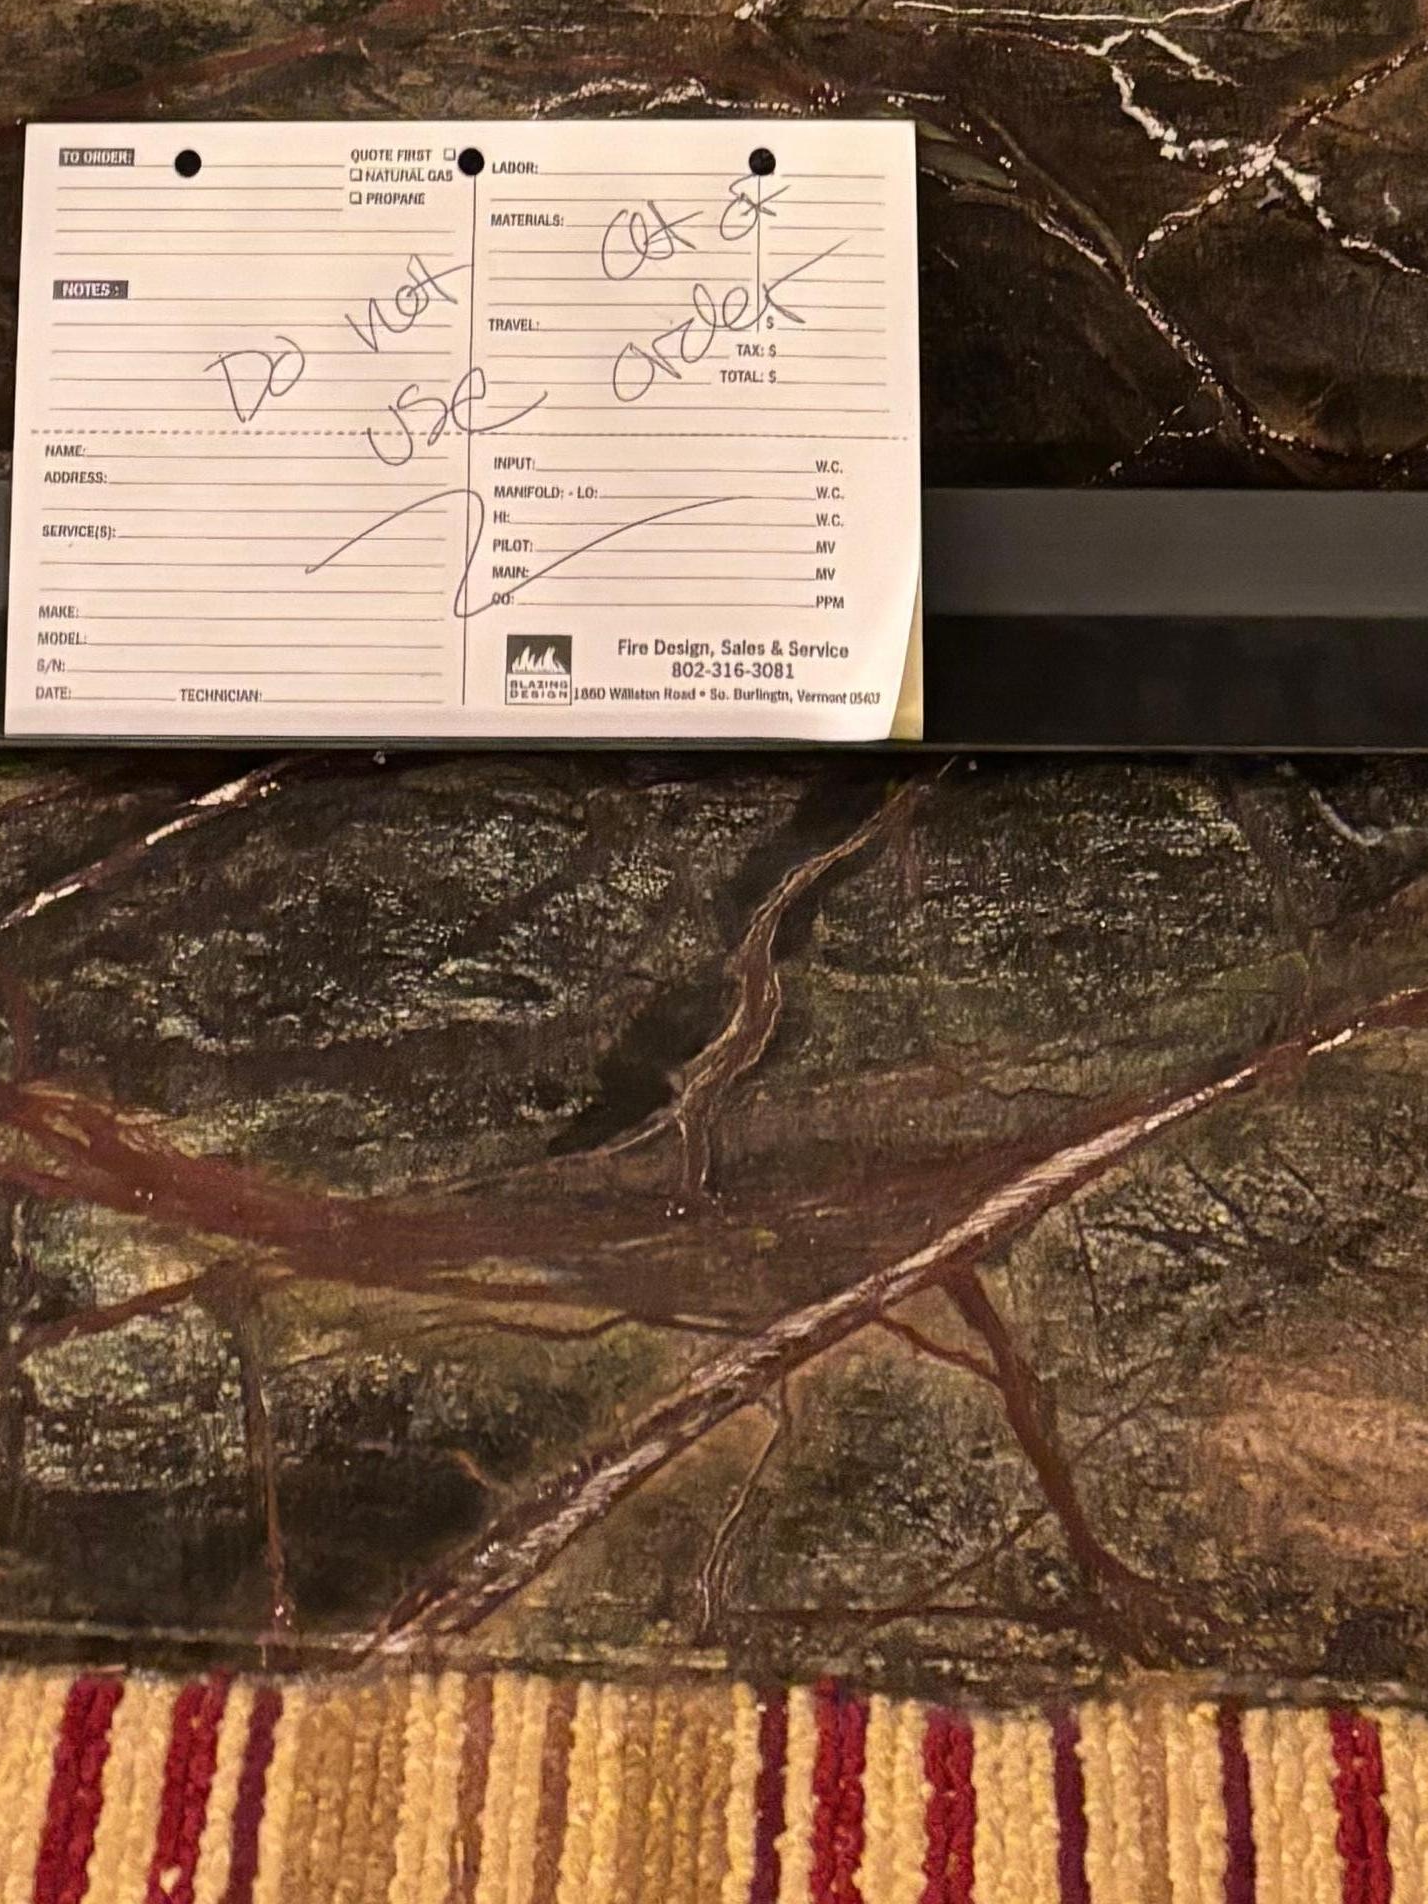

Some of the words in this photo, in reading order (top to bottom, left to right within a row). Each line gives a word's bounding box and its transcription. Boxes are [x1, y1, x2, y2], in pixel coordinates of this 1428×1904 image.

[63, 150, 80, 164] TO
[83, 150, 134, 164] ORDER:
[350, 149, 393, 163] QUOTE
[397, 149, 432, 162] FIRST
[365, 169, 424, 182] NATURAL
[428, 170, 453, 182] GAS
[492, 162, 538, 175] LABOR:
[366, 192, 425, 205] PROPANE
[490, 214, 564, 227] MATERIALS:
[488, 318, 540, 332] TRAVEL:
[203, 335, 305, 423] Do
[344, 254, 472, 352] not
[737, 344, 764, 357] TAX:
[768, 343, 777, 357] $
[720, 370, 764, 383] TOTAL:
[768, 369, 777, 383] $
[367, 367, 548, 465] use
[45, 444, 86, 457] NAME:
[493, 456, 535, 471] INPUT:
[815, 460, 844, 474] W.C.
[44, 471, 107, 485] ADDRESS:
[493, 485, 564, 499] MANIFOLD:
[577, 485, 598, 499] LO:
[815, 486, 845, 500] W.C.
[493, 511, 510, 524] HI:
[815, 513, 845, 527] W.C.
[42, 525, 116, 540] SERVICE(S):
[492, 539, 533, 553] PILOT:
[815, 541, 836, 555] MV
[492, 566, 529, 579] MAIN:
[815, 567, 836, 581] MV
[815, 596, 845, 610] PPM
[38, 605, 79, 619] MAKE:
[37, 631, 87, 645] MODEL:
[618, 639, 649, 655] Fire
[654, 639, 714, 658] Design,
[721, 639, 765, 656] Sales
[771, 640, 783, 656] &
[789, 641, 849, 659] Service
[37, 658, 66, 674] S/N:
[671, 661, 794, 679] 802-316-3081
[510, 680, 568, 689] BLAZING
[35, 686, 72, 700] DATE:
[180, 688, 262, 703] TECHNICIAN:
[510, 690, 568, 699] DESIGN
[664, 687, 696, 700] Road
[710, 688, 729, 700] So.
[798, 689, 846, 704] Vermont
